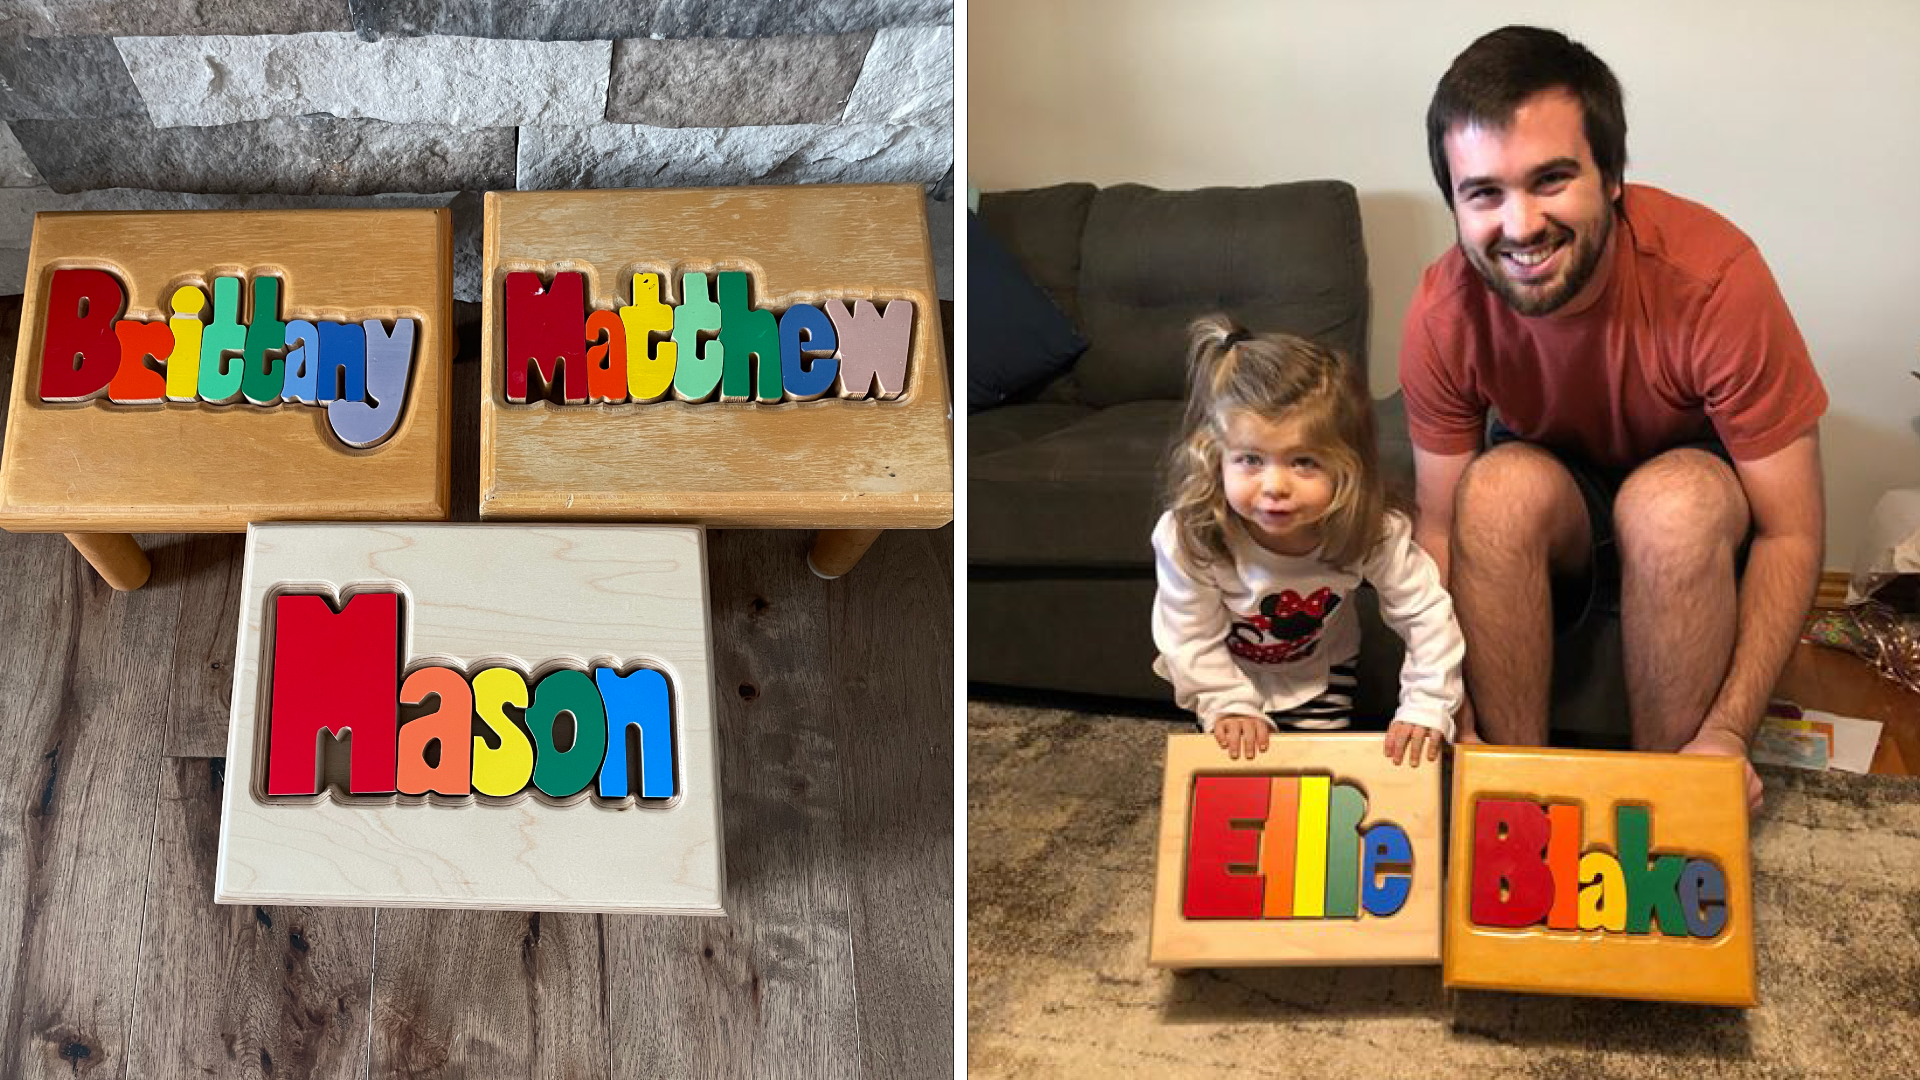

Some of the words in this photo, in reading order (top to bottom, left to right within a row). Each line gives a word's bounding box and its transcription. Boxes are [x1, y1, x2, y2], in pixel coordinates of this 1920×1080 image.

[40, 269, 415, 444] Brittany
[506, 271, 913, 399] Matthew
[268, 593, 674, 799] Mason
[1471, 800, 1726, 938] Blake
